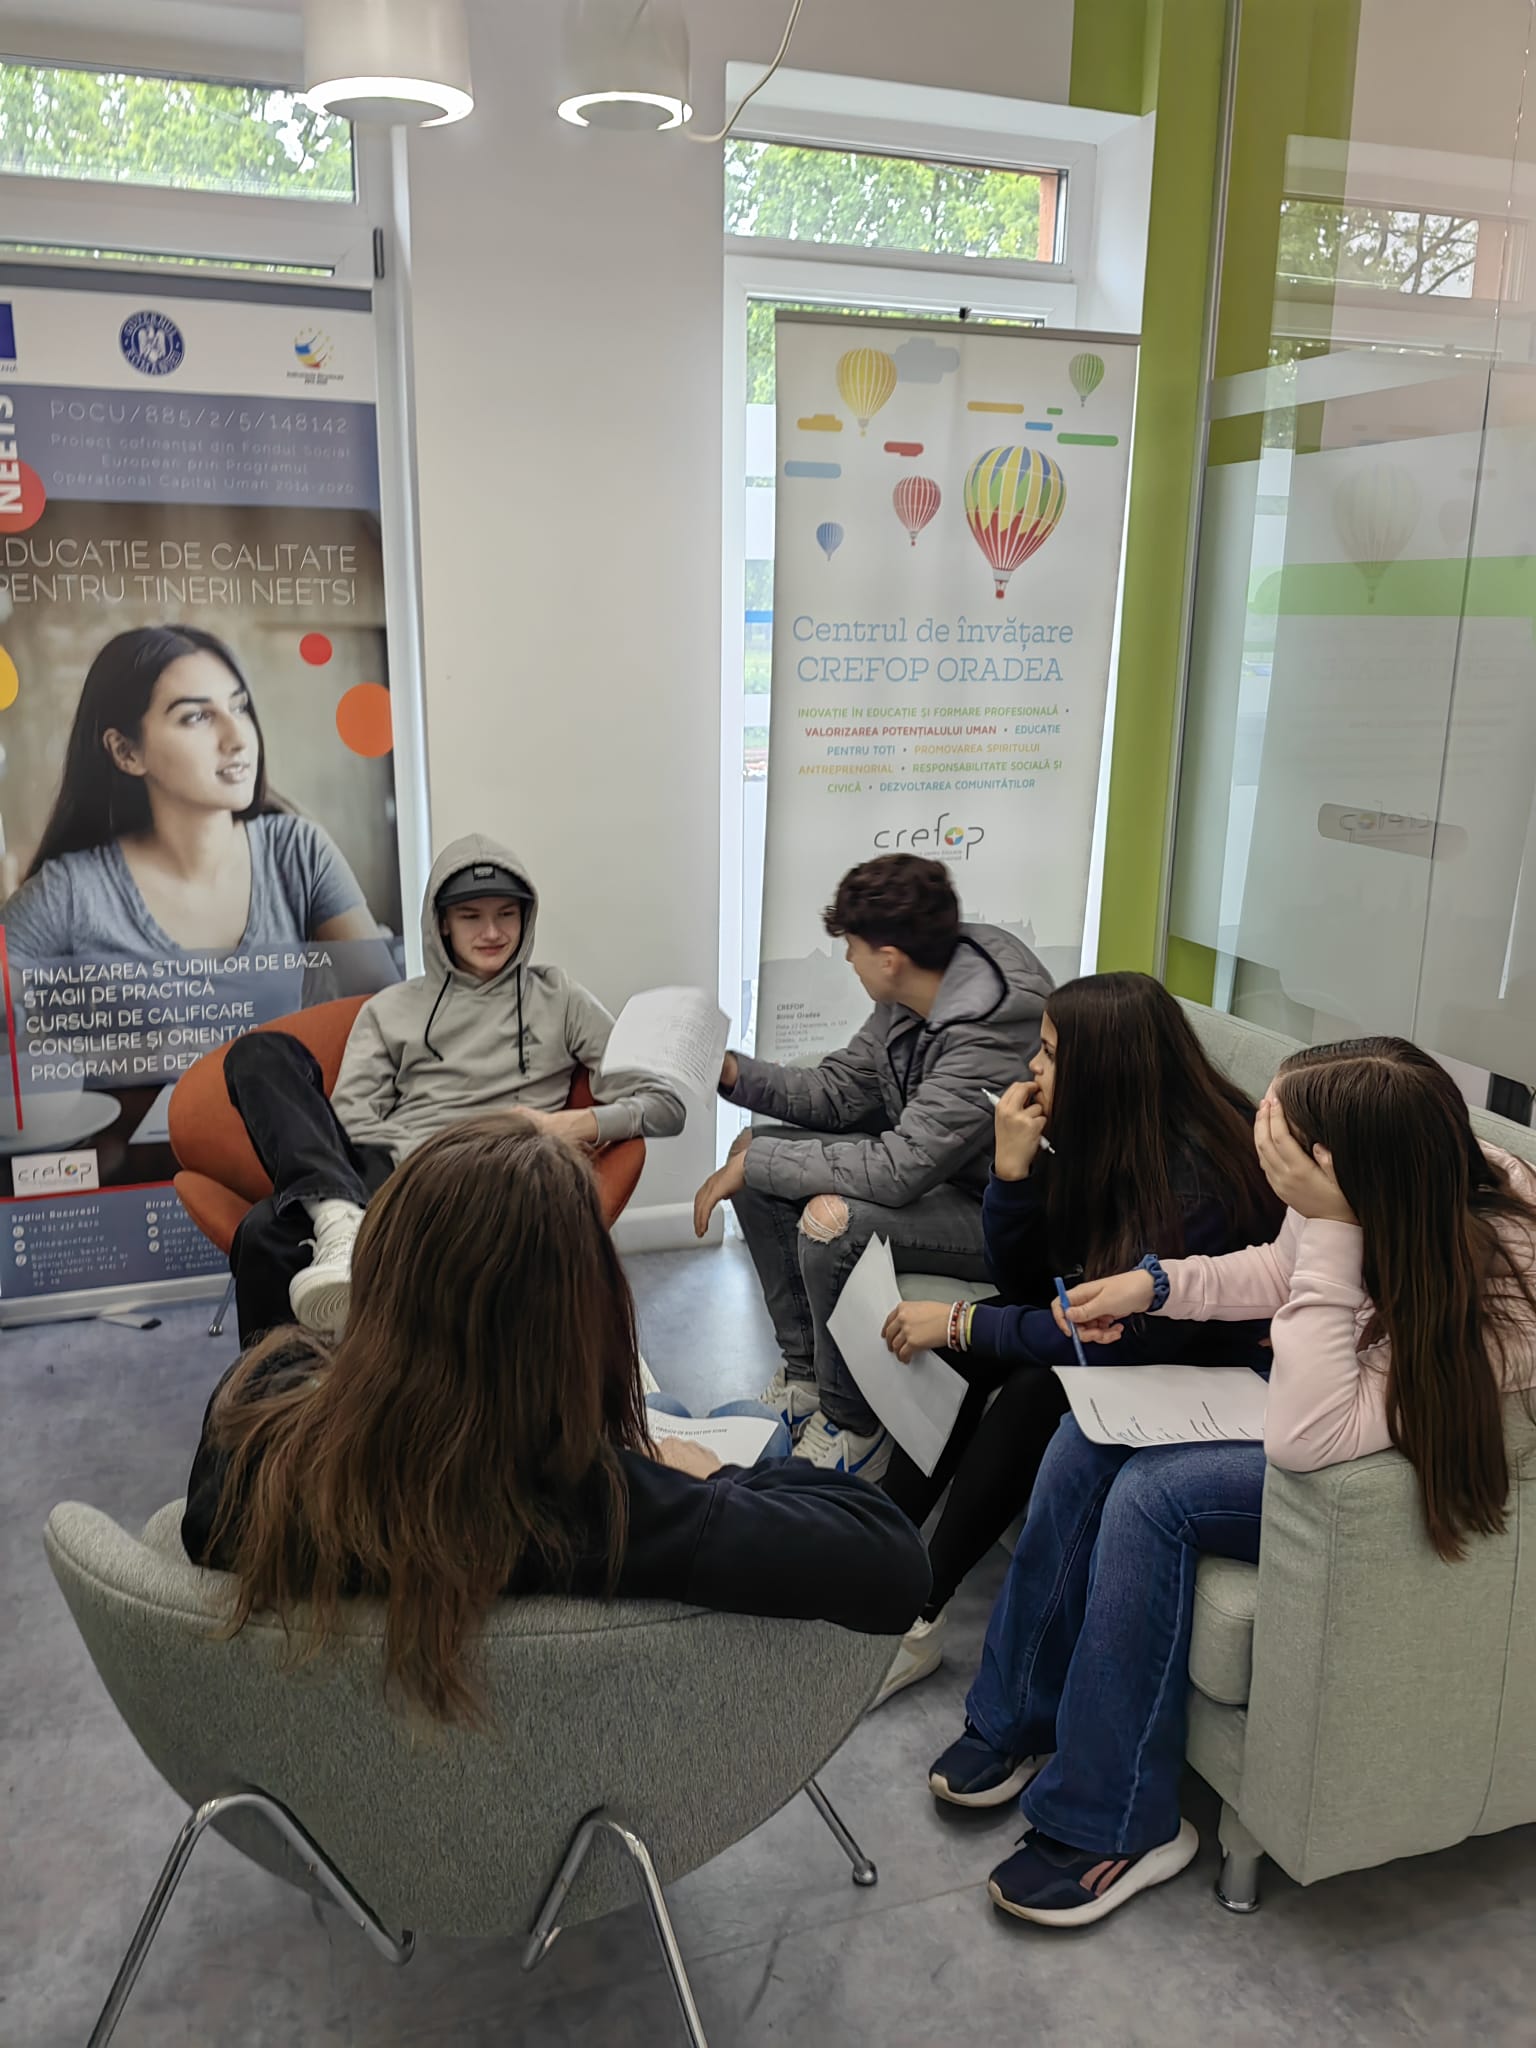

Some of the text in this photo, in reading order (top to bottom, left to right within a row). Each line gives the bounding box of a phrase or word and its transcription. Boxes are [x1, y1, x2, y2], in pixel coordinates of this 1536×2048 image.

[160, 541, 203, 570] DE
[211, 542, 357, 573] CALITATE
[134, 575, 241, 604] TINERII
[792, 615, 1074, 652] Centrul de învățare
[797, 656, 1064, 683] CREFOP ORADEA
[933, 706, 981, 717] FORMARE
[805, 726, 879, 737] VALORIZAREA
[965, 725, 997, 736] UMAN
[827, 745, 870, 756] PENTRU
[914, 743, 983, 755] PROMOVAREA
[986, 743, 1041, 754] SPIRITULUI
[798, 763, 894, 775] ANTREPRENORIAL
[912, 761, 1008, 773] RESPONSABILITATE
[879, 781, 952, 792] DEZVOLTAREA
[873, 812, 984, 860] crefop
[22, 951, 333, 987] FINALIZAREA STUDIILOR DE BAZA
[24, 987, 86, 1009] STAGII
[91, 985, 118, 1004] DE
[26, 1001, 256, 1034] CURSURI DE CALIFICARE
[28, 1032, 143, 1057] CONSILIERE
[31, 1057, 128, 1082] PROGRAM
[133, 1055, 159, 1073] DE
[18, 1156, 92, 1184] crefop
